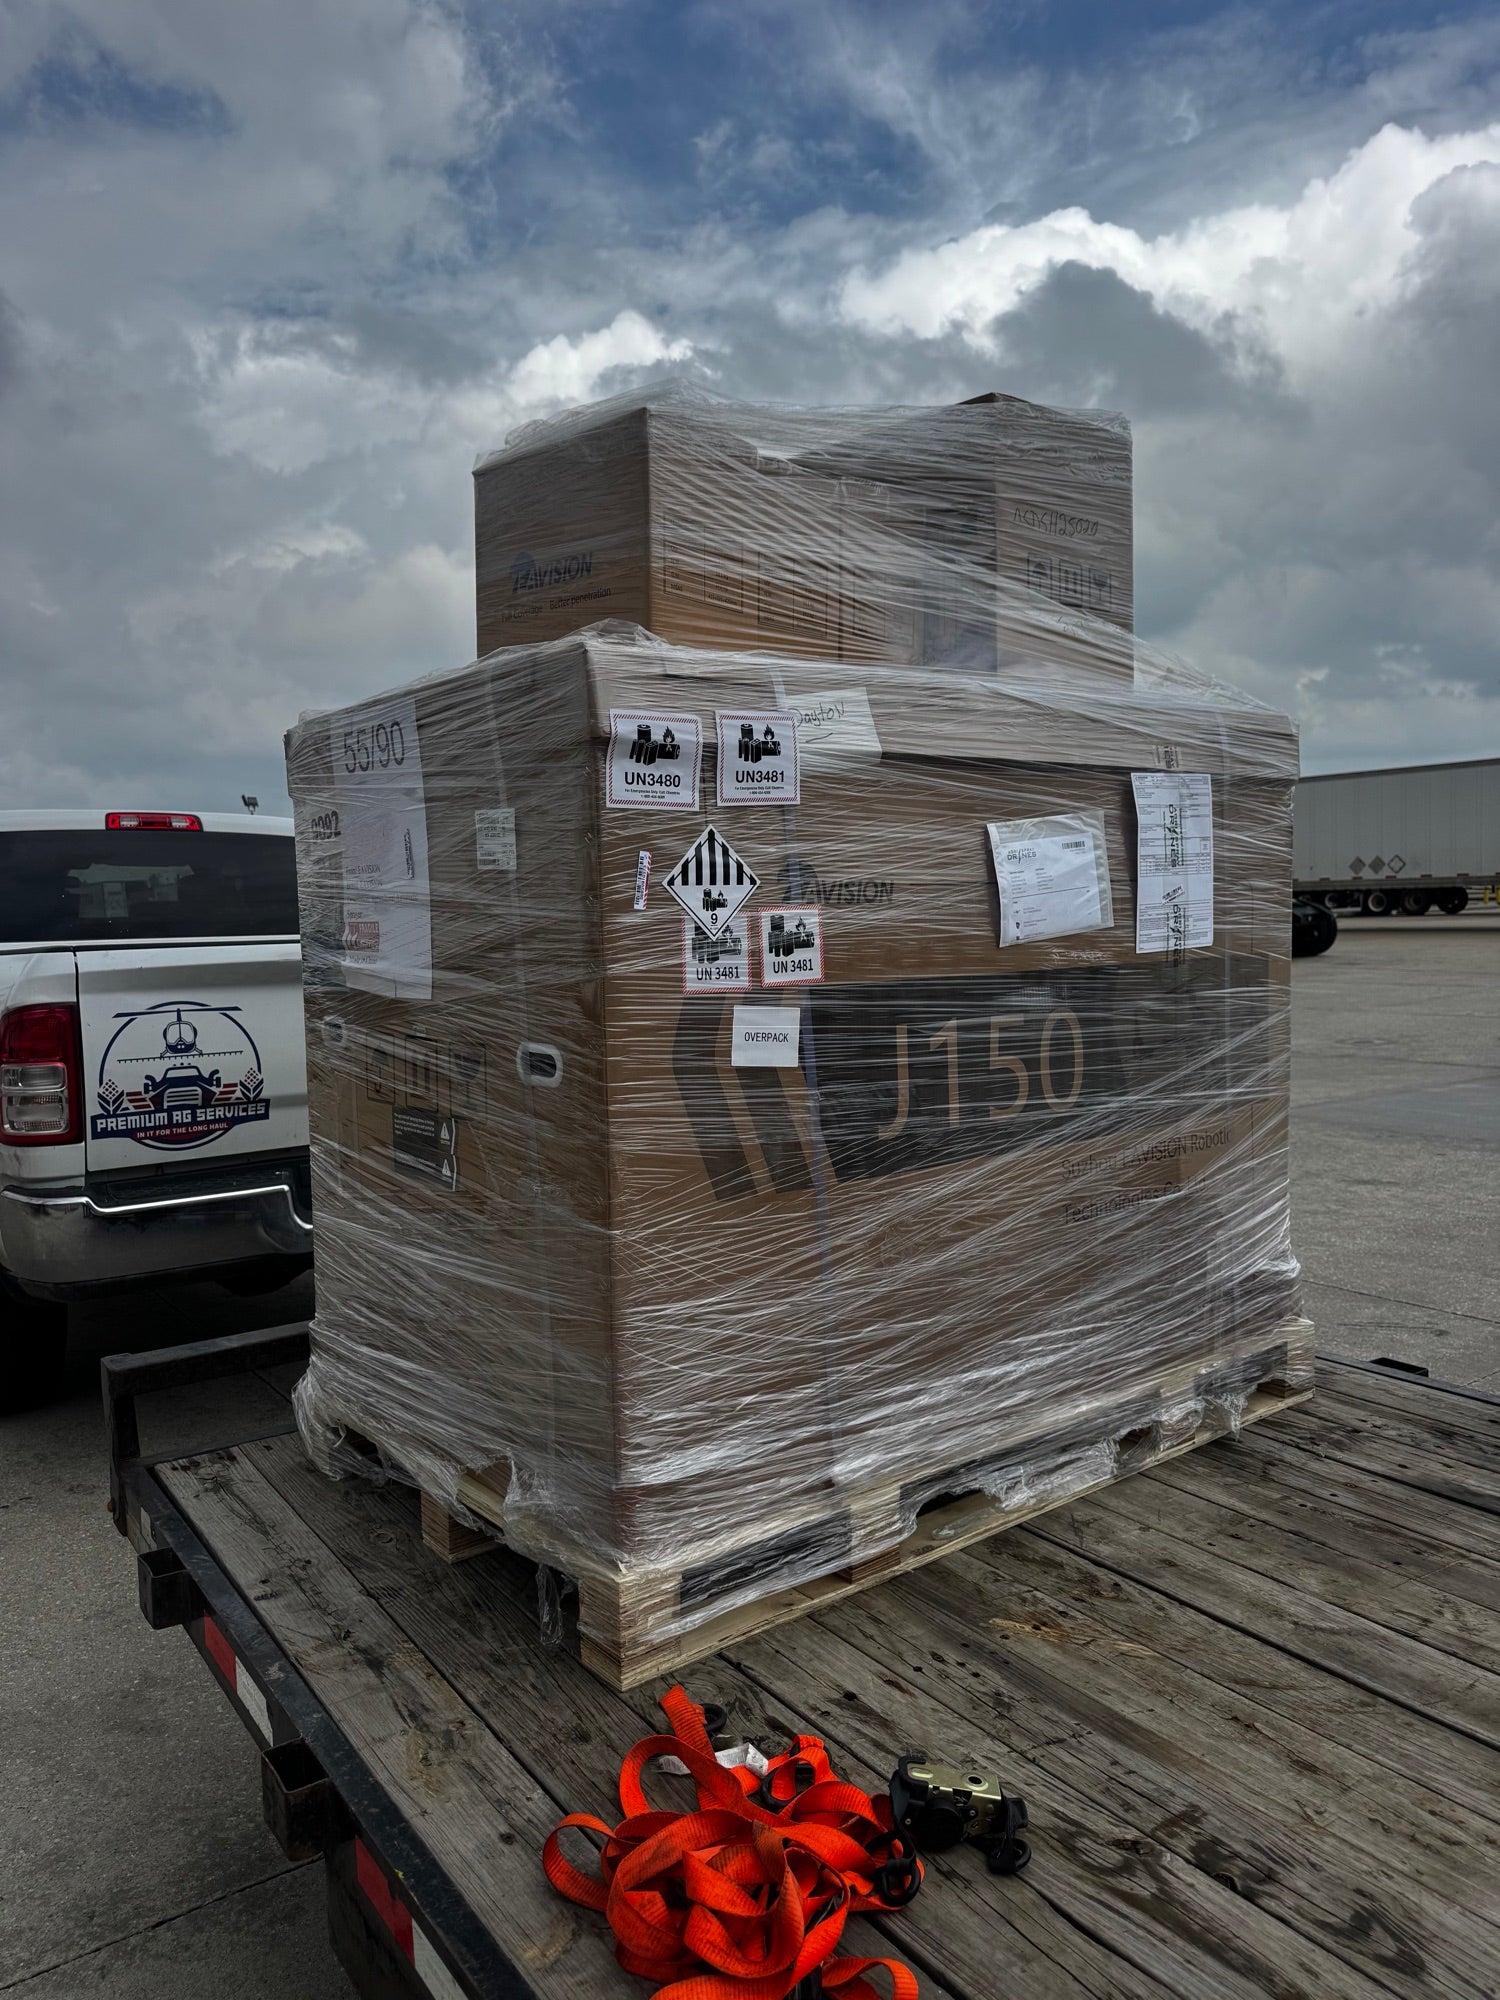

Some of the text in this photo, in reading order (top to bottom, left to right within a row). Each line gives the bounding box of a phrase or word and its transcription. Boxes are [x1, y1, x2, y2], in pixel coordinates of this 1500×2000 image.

[571, 587, 612, 608] penetration
[343, 720, 405, 774] 55/90
[624, 771, 681, 788] UN3480
[735, 769, 786, 784] UN3481
[710, 912, 718, 925] 9
[696, 966, 740, 981] UN 3481
[772, 958, 814, 974] UN 3481
[744, 1031, 790, 1043] OVERPACK
[877, 1006, 1084, 1140] J150
[96, 1103, 267, 1133] PREMIUM AG SERVICES
[156, 1129, 171, 1137] FOR
[172, 1127, 188, 1135] THE
[188, 1125, 209, 1133] LONG
[209, 1123, 229, 1131] HAUL
[1190, 1126, 1233, 1153] Robotic
